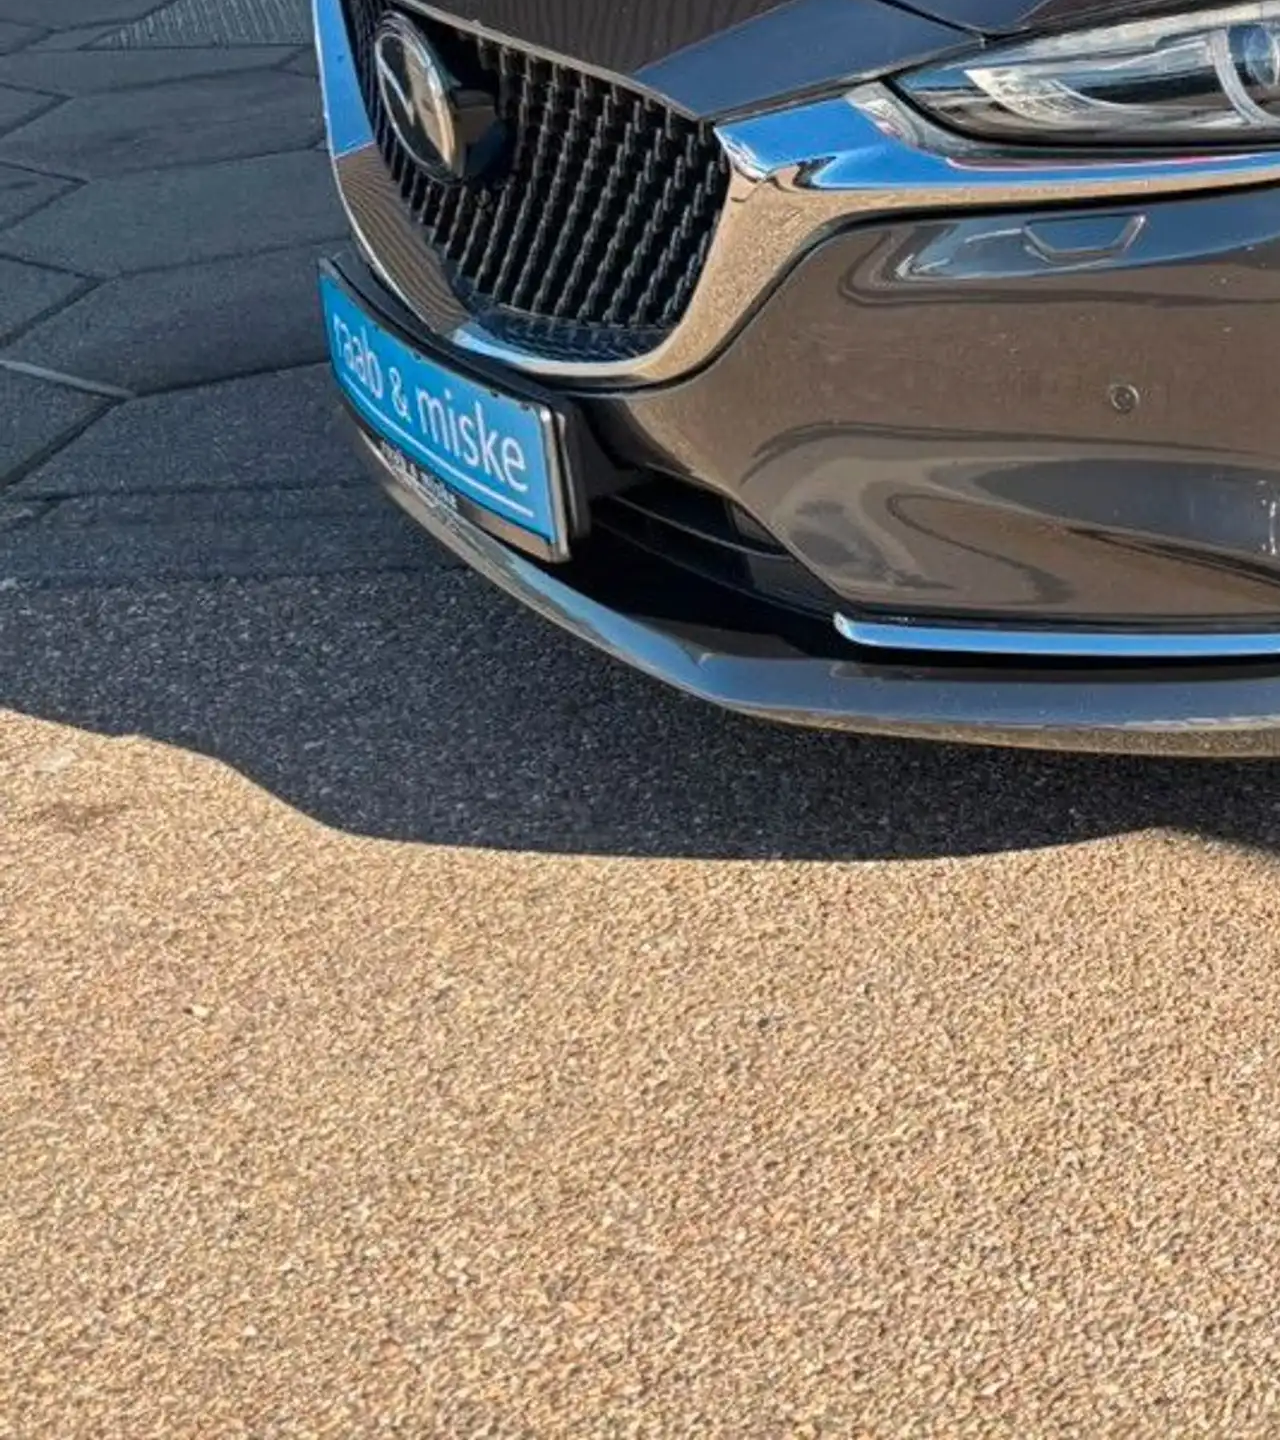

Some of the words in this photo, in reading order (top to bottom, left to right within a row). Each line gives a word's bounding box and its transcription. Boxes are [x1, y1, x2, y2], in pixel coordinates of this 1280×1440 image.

[333, 312, 383, 400] raab
[389, 366, 412, 424] &
[415, 386, 530, 493] miske
